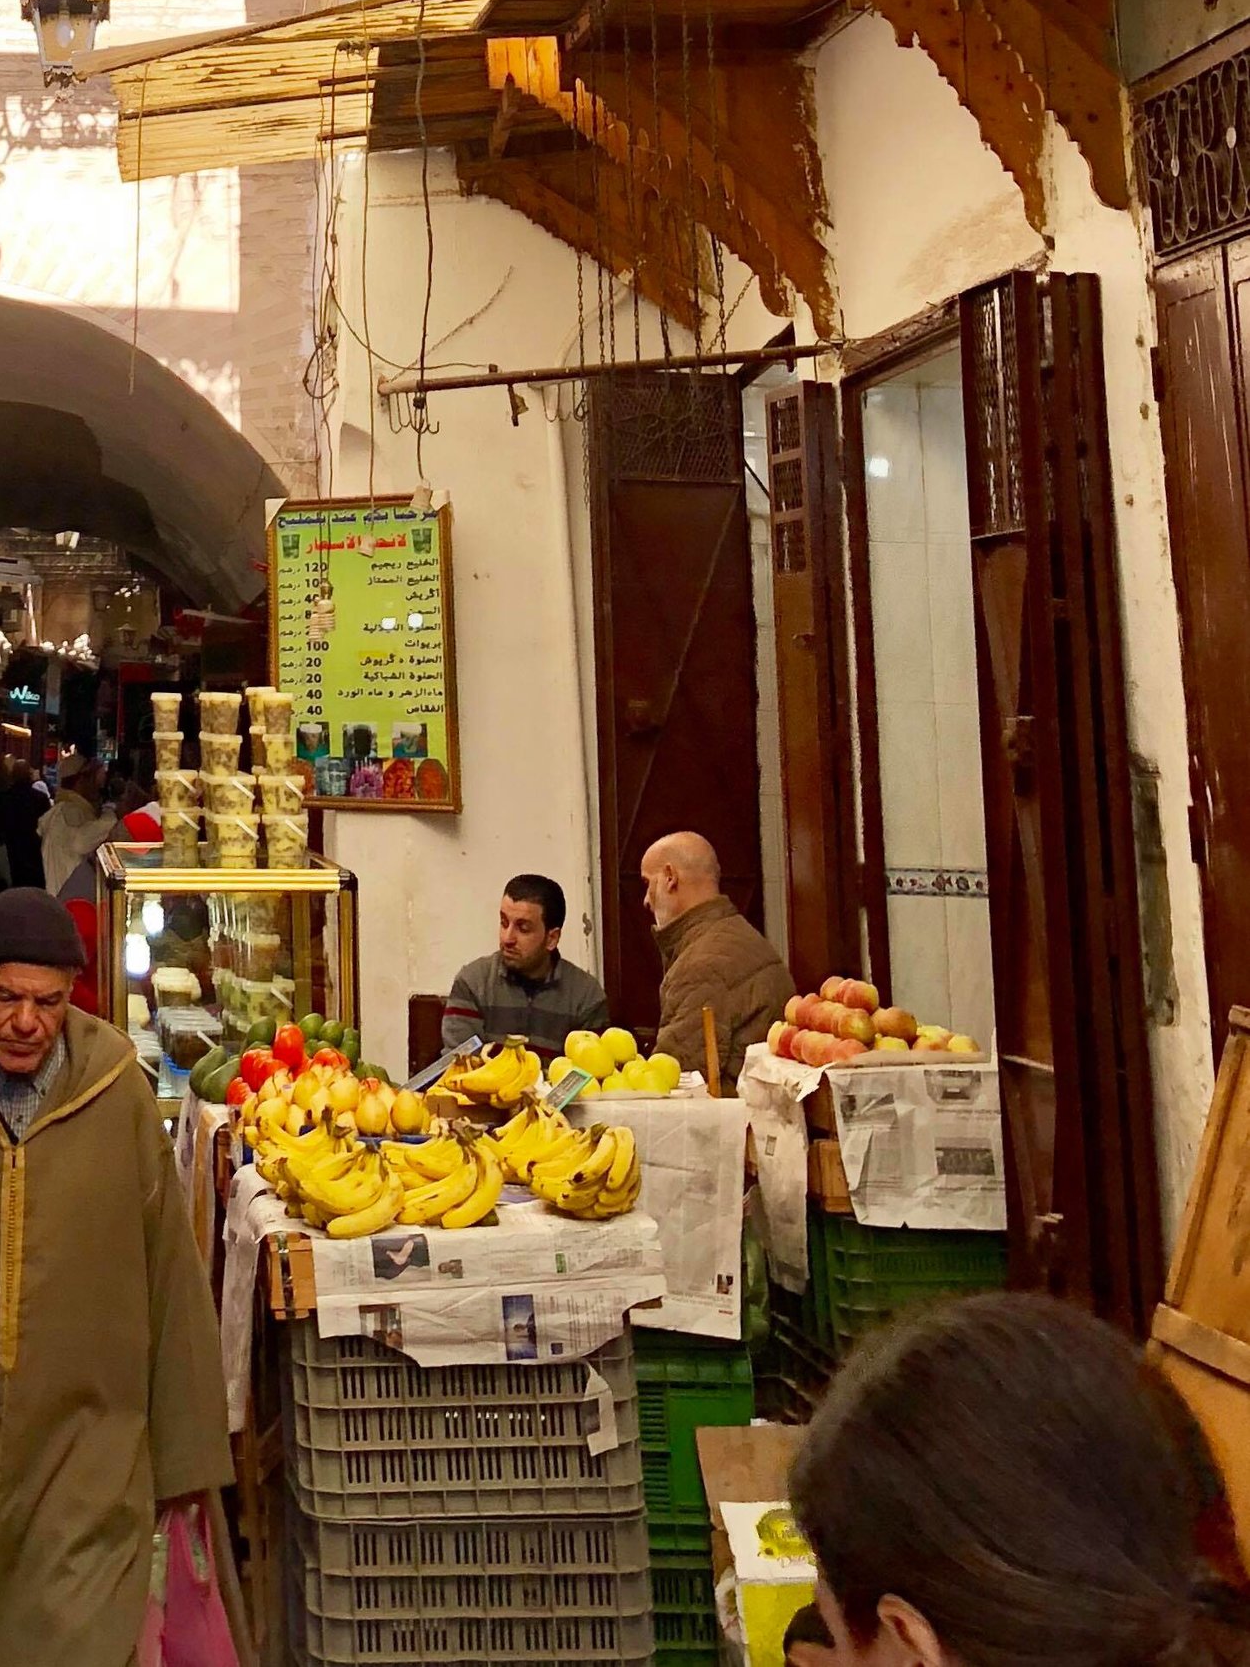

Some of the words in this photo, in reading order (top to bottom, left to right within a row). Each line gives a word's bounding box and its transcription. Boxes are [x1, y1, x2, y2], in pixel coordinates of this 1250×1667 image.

[305, 562, 328, 572] 120
[306, 641, 329, 651] 100
[404, 639, 441, 649] بريوات
[306, 657, 322, 668] 20
[409, 655, 442, 665] الحلوة
[306, 673, 322, 683] 20
[409, 672, 443, 682] الحلوة
[10, 685, 40, 700] Wiko
[306, 689, 322, 699] 40
[338, 688, 363, 698] الورد
[307, 705, 323, 715] 40
